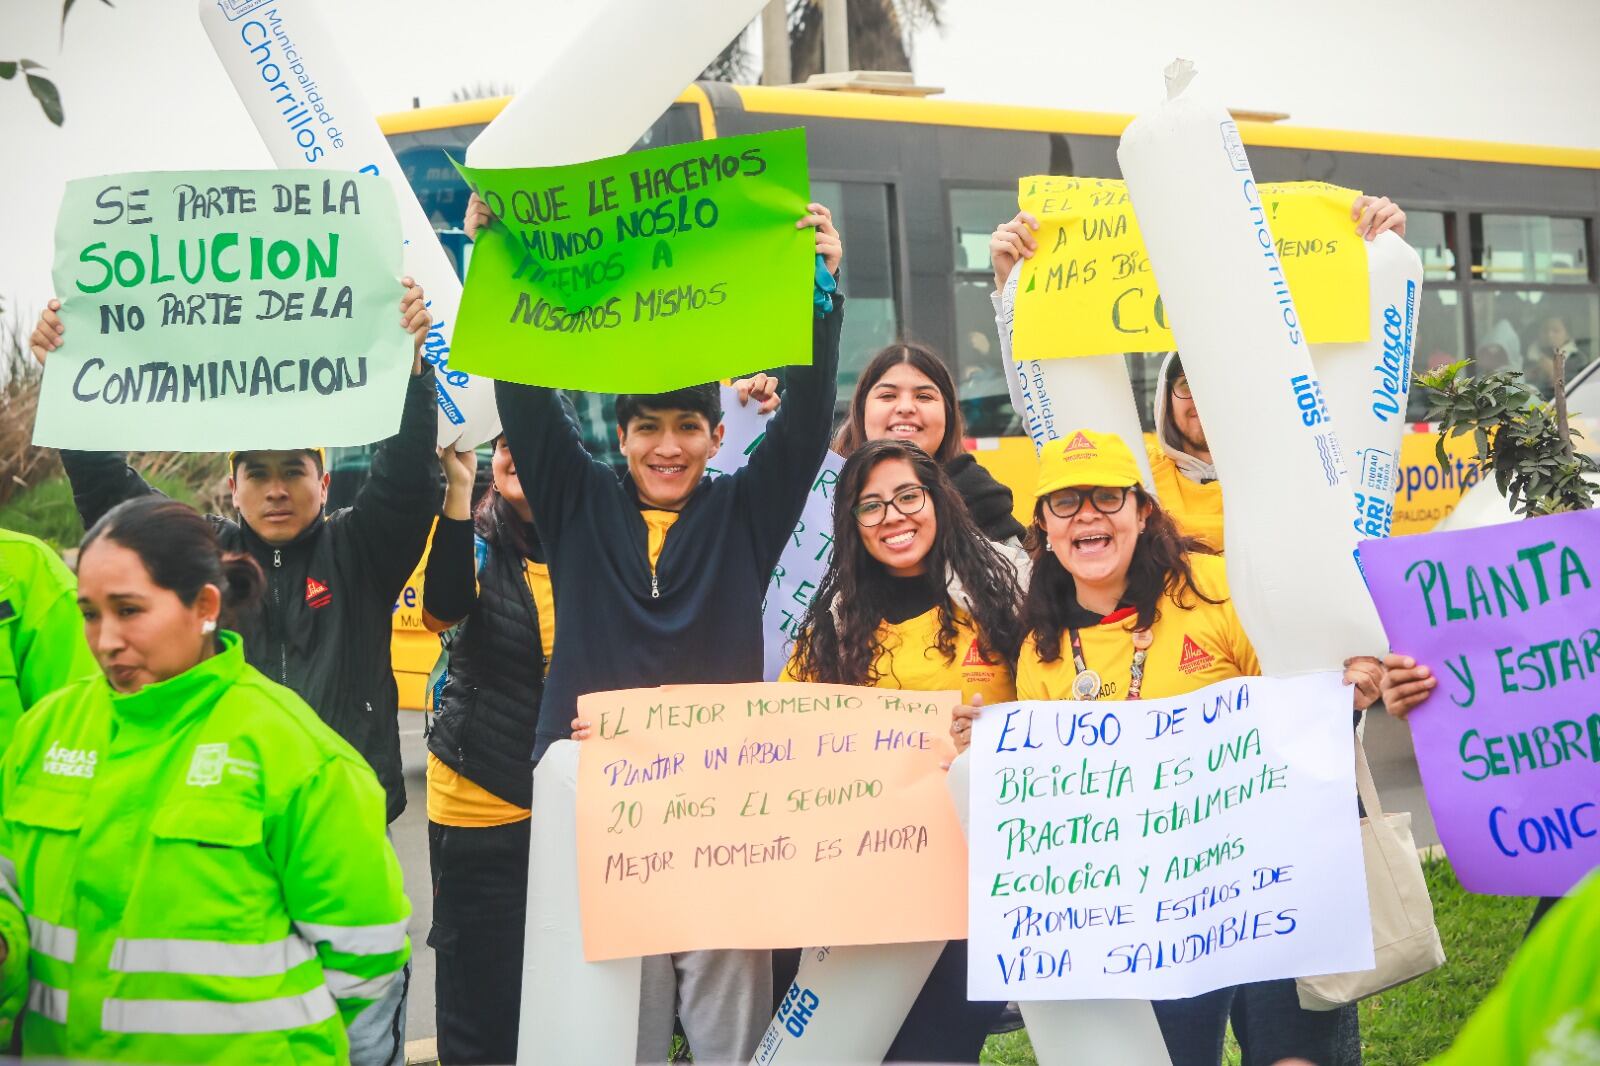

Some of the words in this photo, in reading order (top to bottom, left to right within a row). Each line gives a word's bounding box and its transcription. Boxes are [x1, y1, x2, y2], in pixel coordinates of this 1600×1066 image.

[241, 21, 324, 163] Chorrillos
[264, 8, 335, 124] Municipalidad
[327, 127, 344, 149] de
[93, 186, 153, 225] SE
[173, 182, 257, 222] PARTE
[272, 184, 312, 215] DE
[323, 180, 360, 215] LA
[511, 185, 571, 226] QUE
[588, 176, 620, 218] LE
[631, 148, 767, 203] HACEMOS
[1041, 198, 1072, 214] EL
[520, 226, 604, 262] MUNDO
[652, 240, 673, 270] A
[1052, 226, 1067, 254] A
[1083, 214, 1127, 241] UNA
[75, 232, 340, 294] SOLUCION
[100, 304, 145, 334] NO
[157, 293, 242, 328] PARTE
[256, 290, 303, 321] DE
[310, 286, 353, 320] LA
[509, 291, 622, 333] NOSOTROS
[72, 356, 368, 405] CONTAMINACION
[1372, 303, 1403, 422] Velasco
[1367, 454, 1379, 489] CIUDAD
[1403, 540, 1592, 628] PLANTA
[1444, 654, 1476, 709] Y
[1494, 628, 1600, 693] ESTAR
[599, 711, 629, 740] EL
[646, 702, 725, 730] MEJOR
[746, 693, 863, 717] MOMENTO
[877, 694, 939, 716] PARA
[996, 708, 1044, 754] EL
[1055, 711, 1122, 748] USO
[1145, 706, 1189, 742] DE
[1202, 683, 1251, 726] UNA
[43, 760, 95, 779] VERDES
[46, 741, 97, 765] ÁREAS
[603, 752, 686, 788] PLANTAR
[704, 746, 728, 770] UN
[737, 737, 797, 767] ÁRBOL
[816, 730, 857, 757] FUE
[874, 728, 932, 752] HACE
[1154, 756, 1194, 792] ES
[1207, 727, 1263, 774] UNA
[606, 799, 643, 835] 20
[662, 792, 716, 825] AÑOS
[739, 790, 770, 817] EL
[787, 778, 884, 814] SEGUNDO
[1488, 802, 1598, 858] CONC
[604, 851, 675, 885] MEJOR
[693, 835, 797, 869] MOMENTO
[815, 838, 843, 863] ES
[856, 824, 929, 858] AHORA
[1002, 903, 1136, 941] PROMUEVE
[1252, 864, 1294, 893] DE
[1103, 907, 1299, 976] SALUDABLES
[785, 988, 820, 1039] CHO
